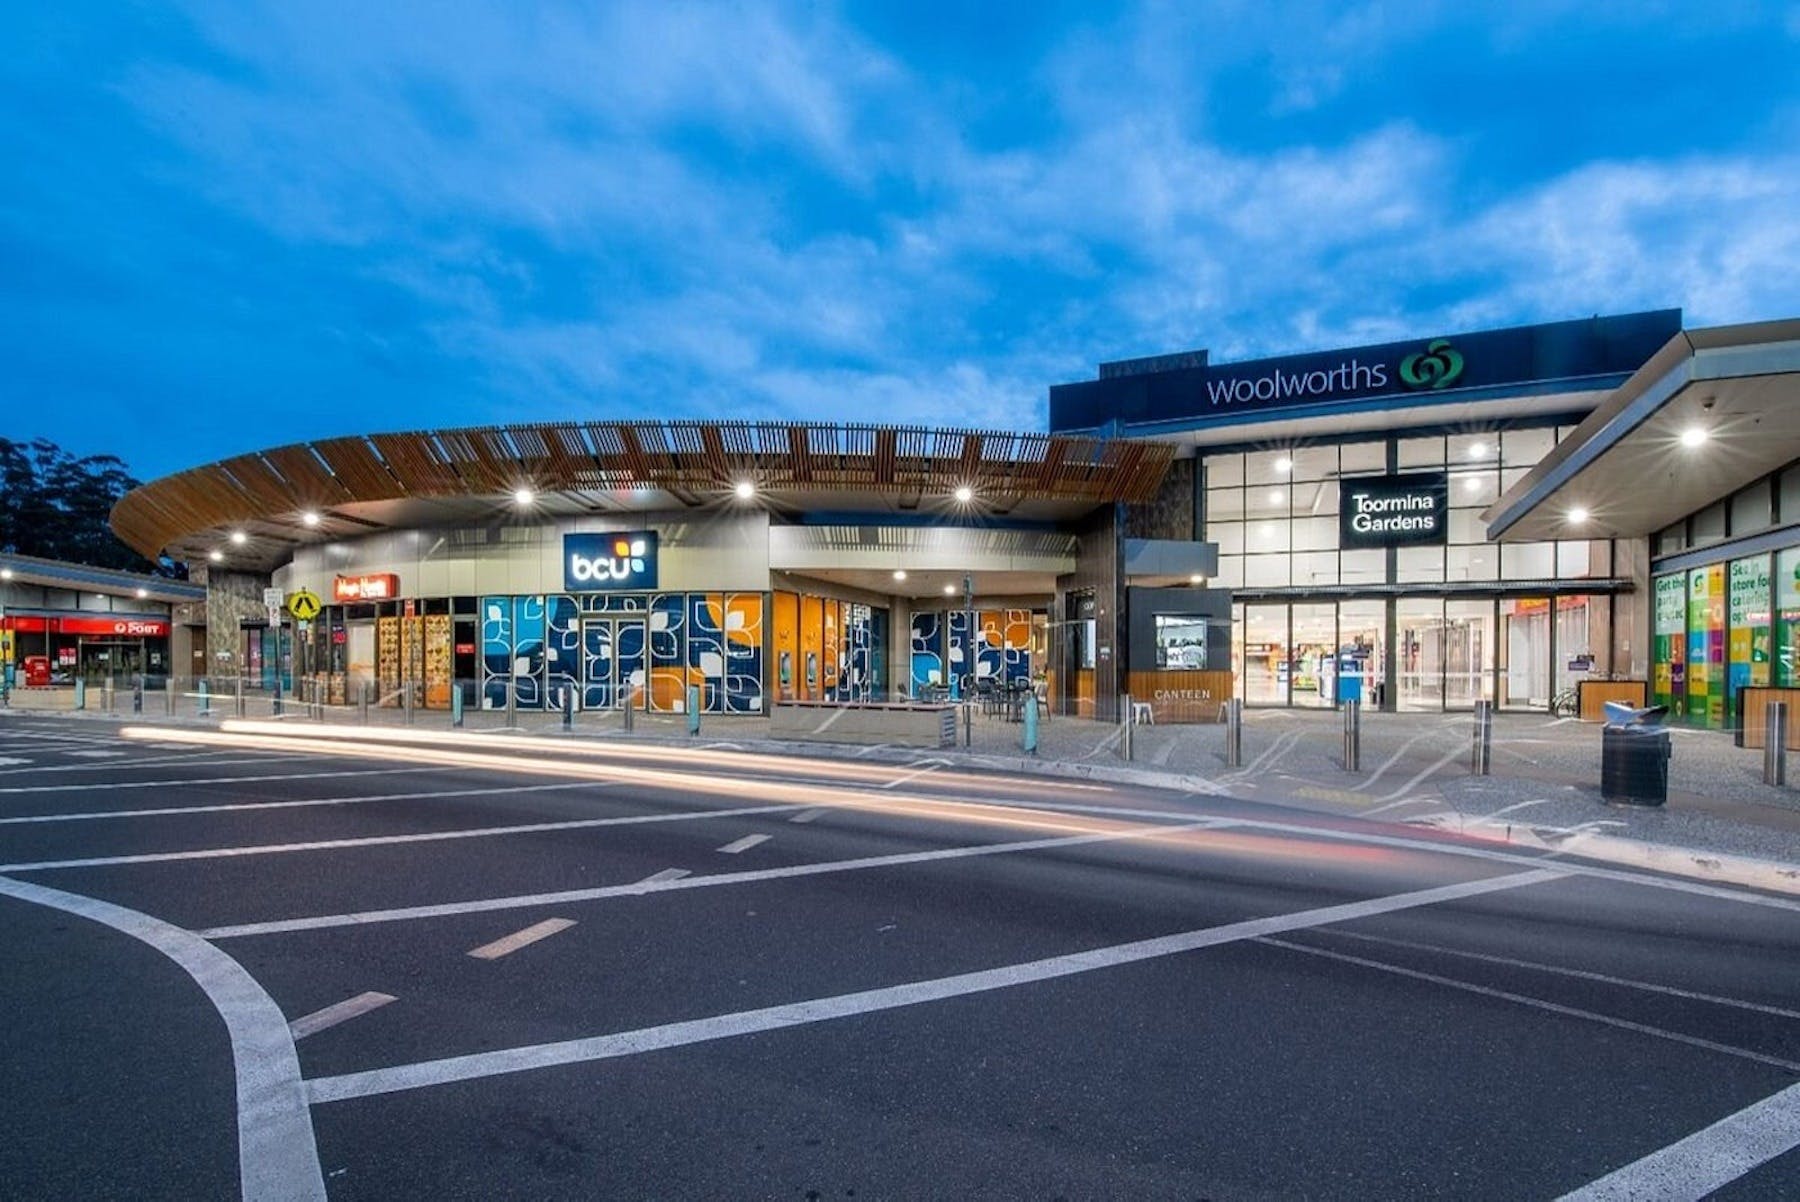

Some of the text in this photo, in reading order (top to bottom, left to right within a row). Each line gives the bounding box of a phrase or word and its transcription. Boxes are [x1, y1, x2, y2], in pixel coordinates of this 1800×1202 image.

[1352, 494, 1434, 513] Toormina
[1352, 513, 1434, 532] Gardens
[572, 553, 630, 581] bcu
[1154, 689, 1211, 700] CANTEEN
